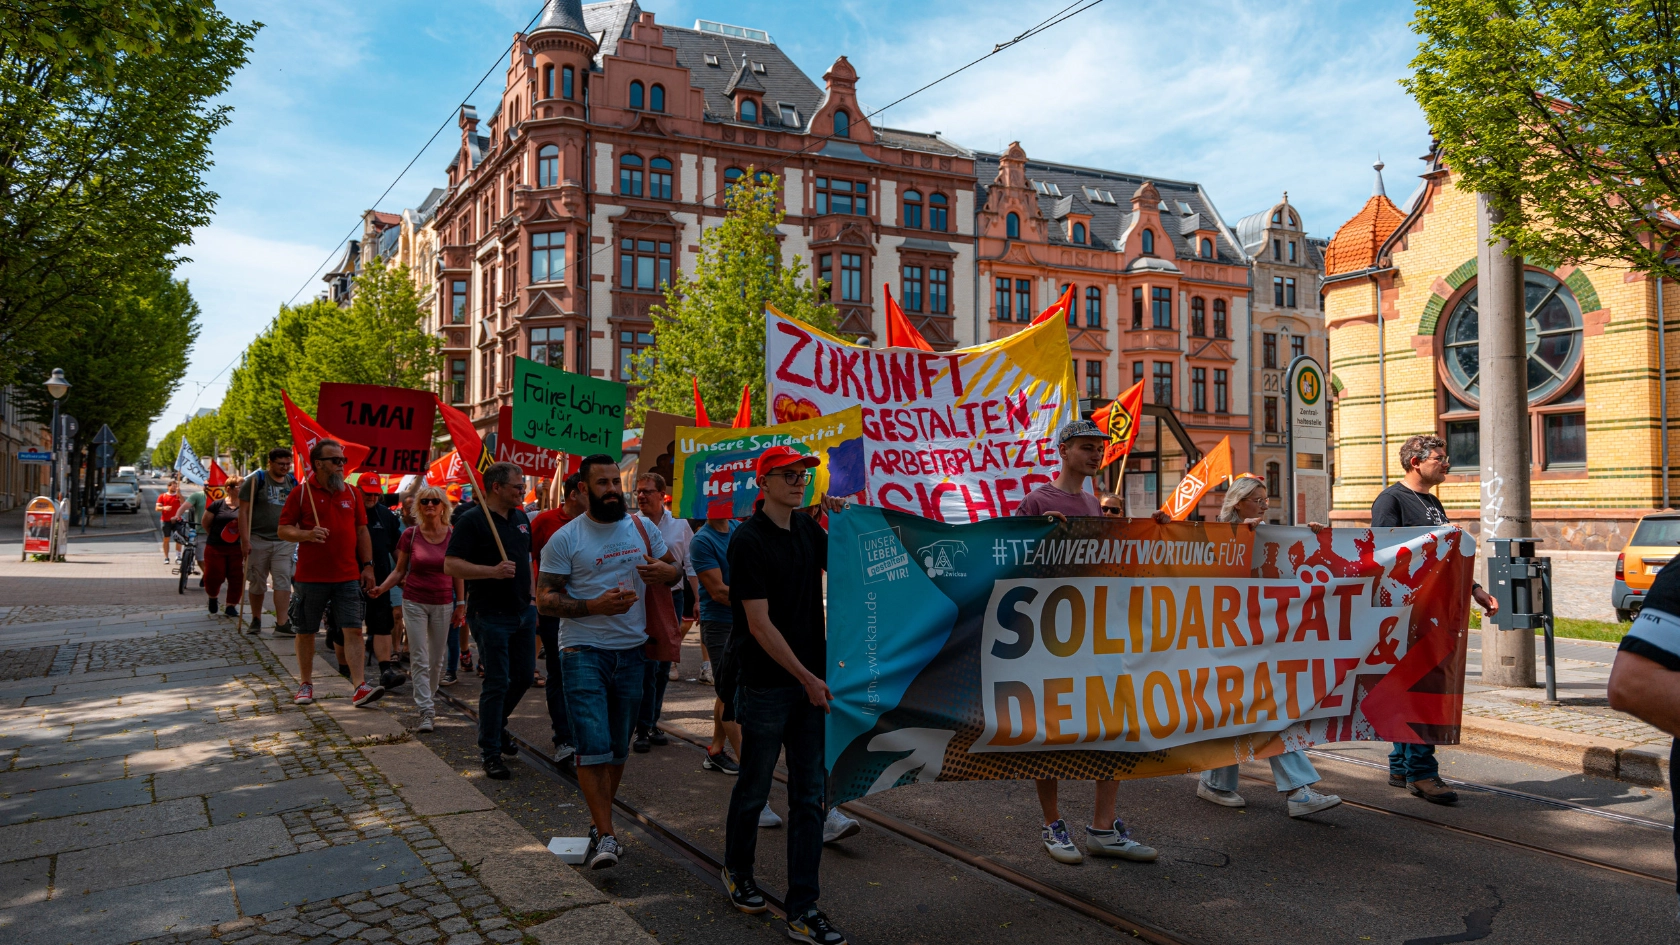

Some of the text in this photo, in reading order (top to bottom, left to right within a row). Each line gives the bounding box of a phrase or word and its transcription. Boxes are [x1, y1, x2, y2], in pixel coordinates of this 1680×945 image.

[776, 322, 967, 404] ZUKUNFT
[524, 373, 621, 418] Faire Löhne
[550, 406, 571, 421] für
[1300, 408, 1319, 416] Zentral-
[524, 419, 612, 448] gute Arbeit
[681, 423, 846, 453] Unsere Solidarität
[392, 449, 428, 472] FREI
[864, 535, 895, 551] UNSER
[868, 546, 897, 562] LEBEN
[992, 538, 1246, 567] #TEAMVERANTWORTUNG FÜR
[870, 556, 906, 575] gestalten
[886, 567, 909, 581] WIR!
[990, 570, 1400, 666] SOLIDARITÄT &
[987, 657, 1361, 747] DEMOKRATIE
